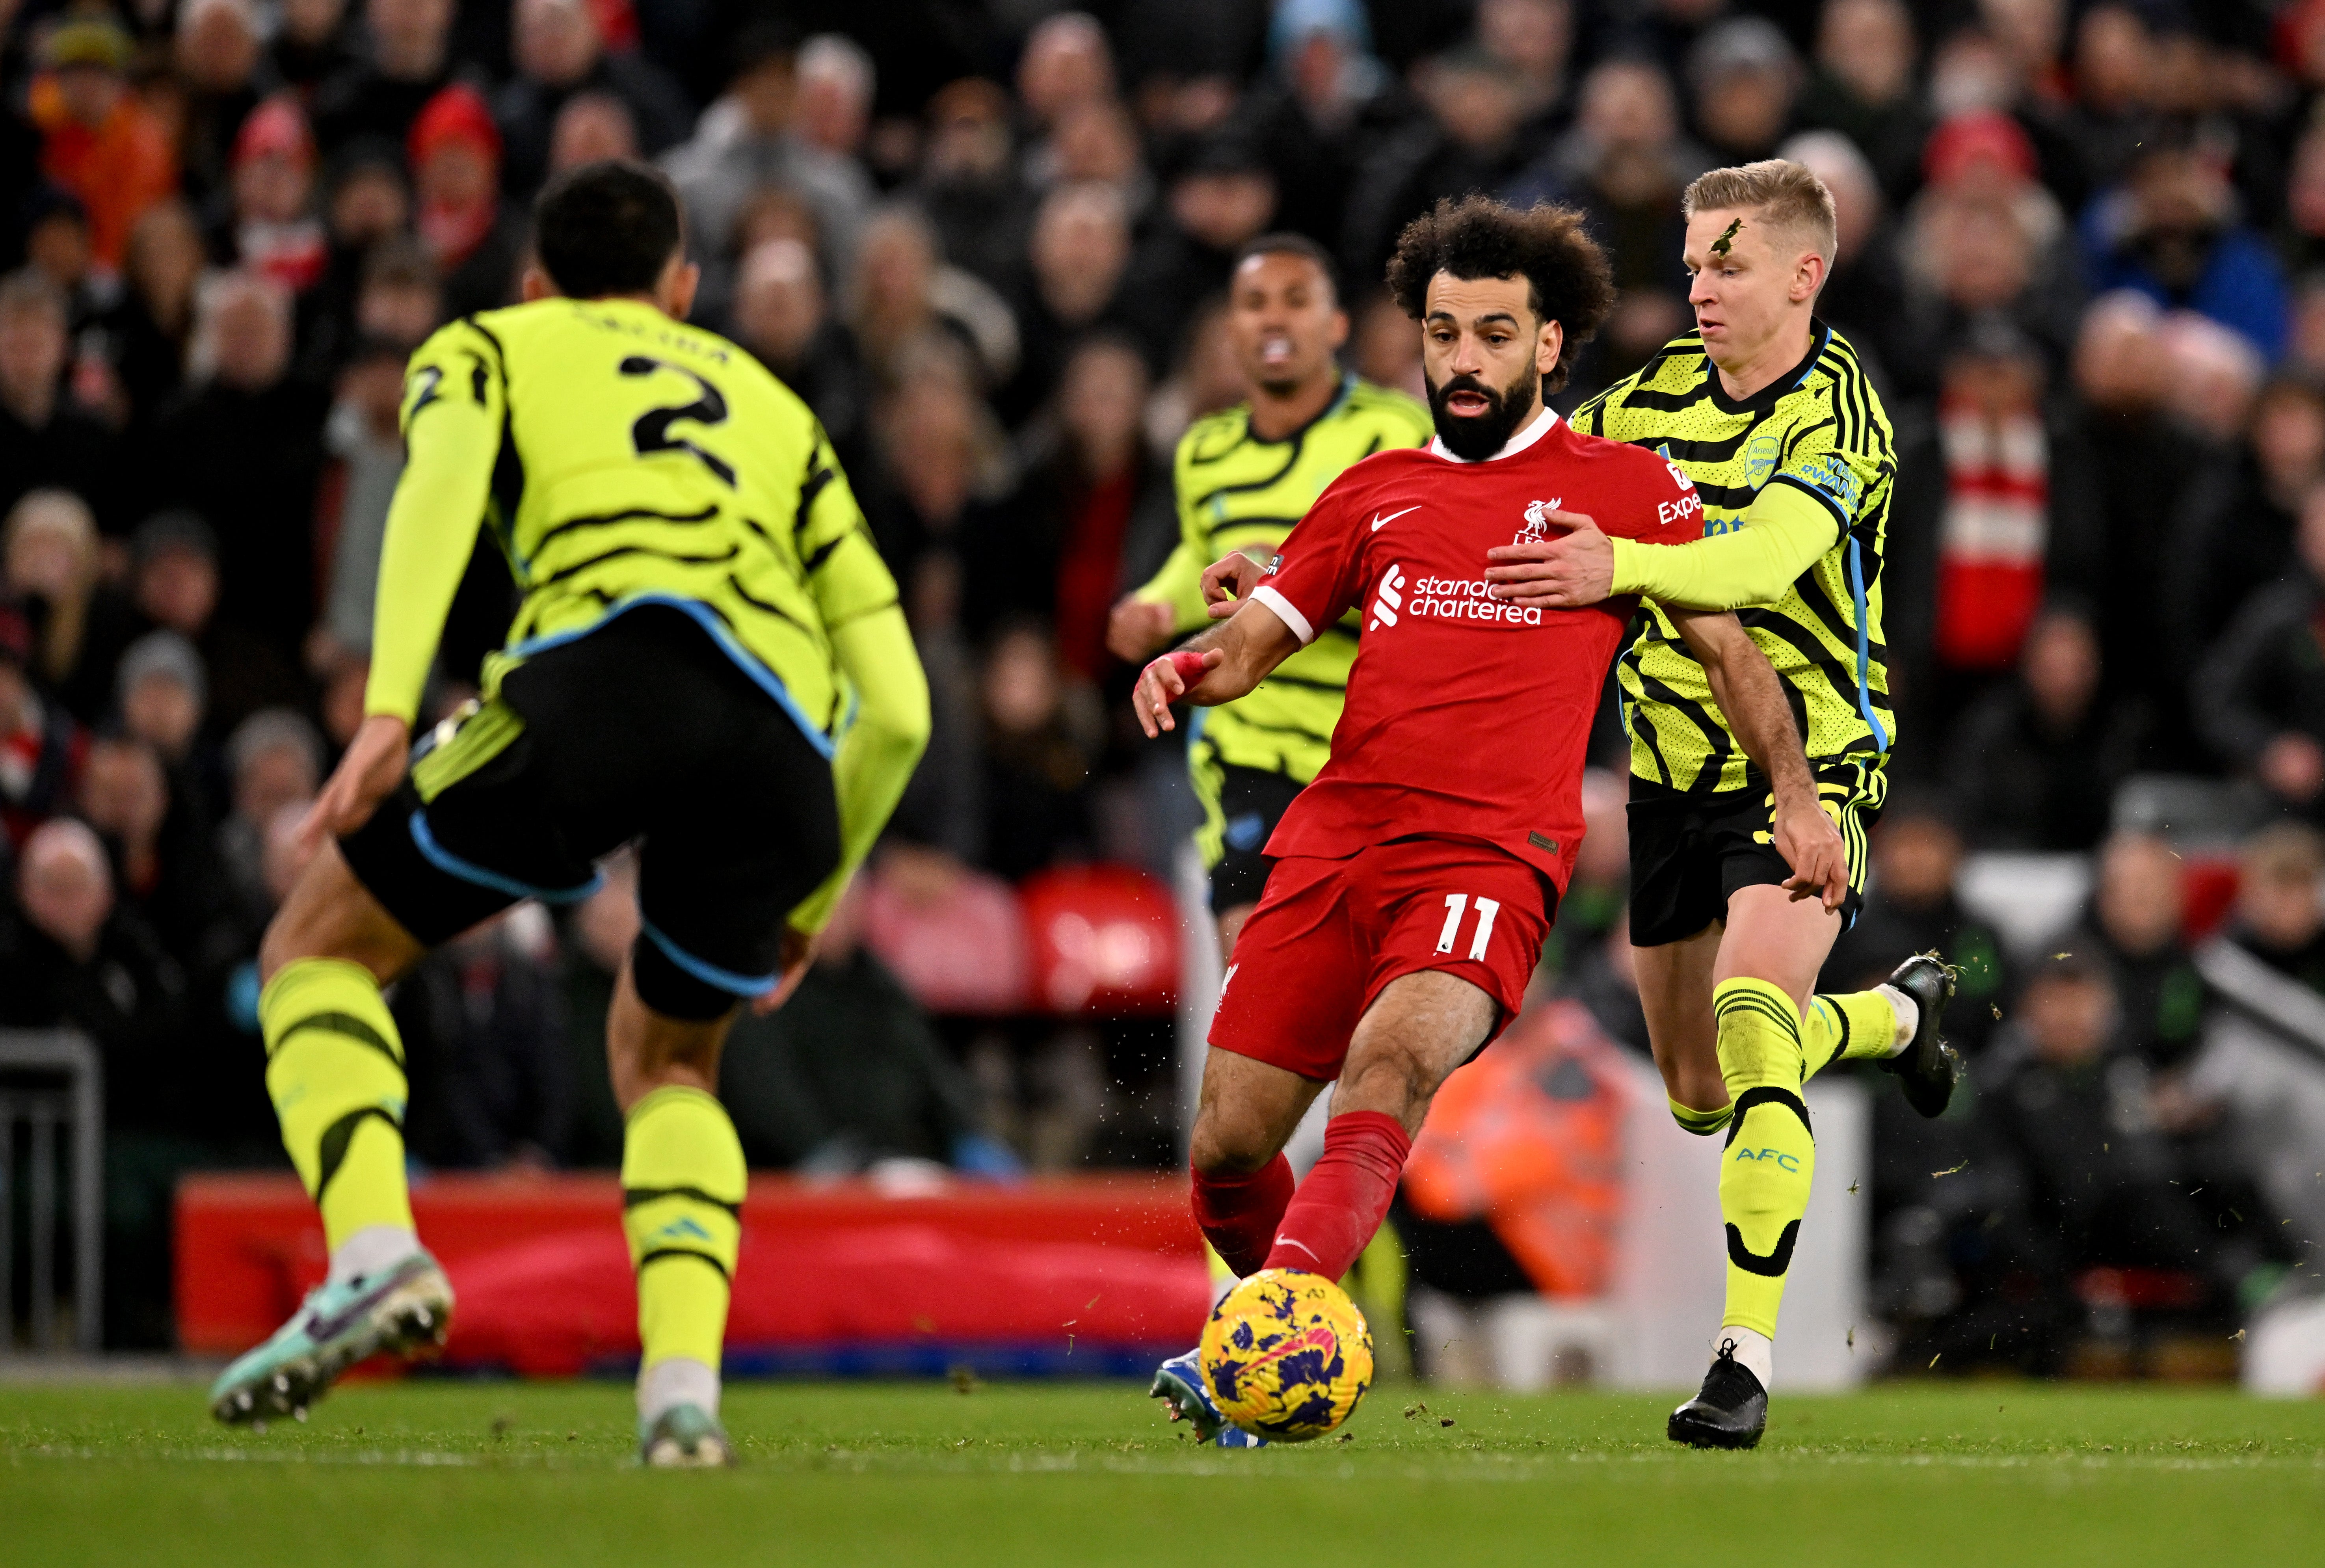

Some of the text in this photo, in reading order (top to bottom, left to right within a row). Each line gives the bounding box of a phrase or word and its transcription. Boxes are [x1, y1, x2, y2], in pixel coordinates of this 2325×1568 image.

[619, 355, 736, 488] 2
[1827, 457, 1858, 489] VISIT
[1436, 893, 1500, 962] 11
[1736, 1148, 1800, 1173] AFC
